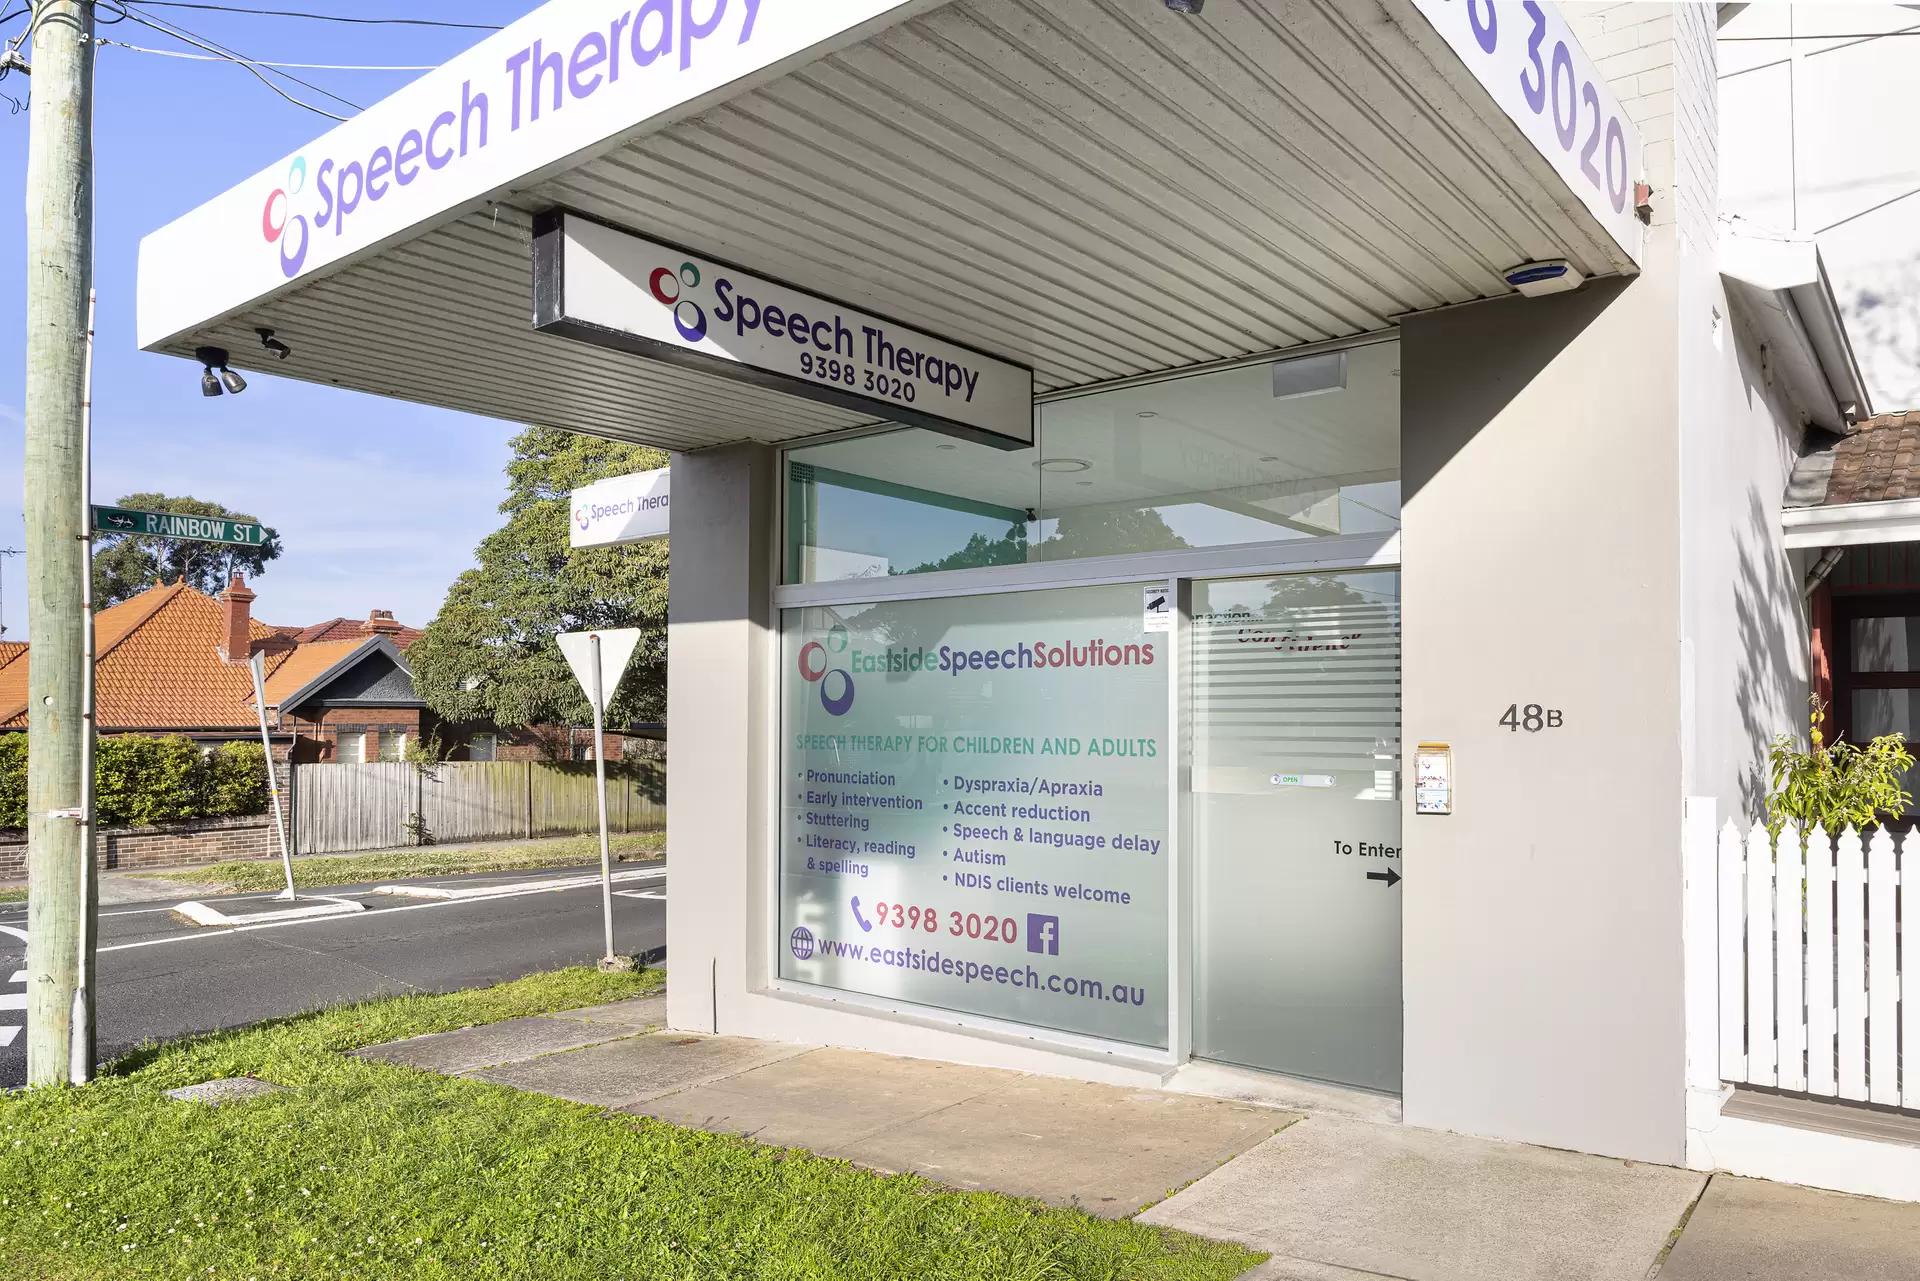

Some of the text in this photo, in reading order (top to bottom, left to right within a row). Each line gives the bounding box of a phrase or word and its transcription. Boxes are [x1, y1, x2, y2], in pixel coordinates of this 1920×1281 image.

[1520, 0, 1627, 214] 3020
[315, 80, 488, 235] Speech
[713, 278, 979, 402] Speech Therapy
[800, 353, 916, 403] 9398 3020
[591, 498, 634, 522] Speech
[146, 513, 252, 542] RAINBOW ST
[1499, 703, 1563, 733] 48B
[796, 734, 1157, 758] SPEECH THERAPY FOR CHILDREN AND ADULTS
[806, 769, 896, 787] Pronunciation
[954, 775, 1103, 797] Dyspraxia/Apraxia
[806, 791, 923, 810] Early intervention
[954, 800, 1090, 822] Accent reduction
[806, 812, 870, 831] Stuttering
[806, 834, 916, 859] Literacy, reading
[953, 823, 1161, 855] Speech & language delay
[1334, 841, 1402, 858] To Enter
[807, 857, 869, 878] & spelling
[953, 848, 1006, 866] Autism
[955, 872, 1131, 904] NDIS clients welcome
[875, 901, 1018, 943] 9398 3020
[817, 938, 1145, 1006] www.eastsidespeech.com.au
